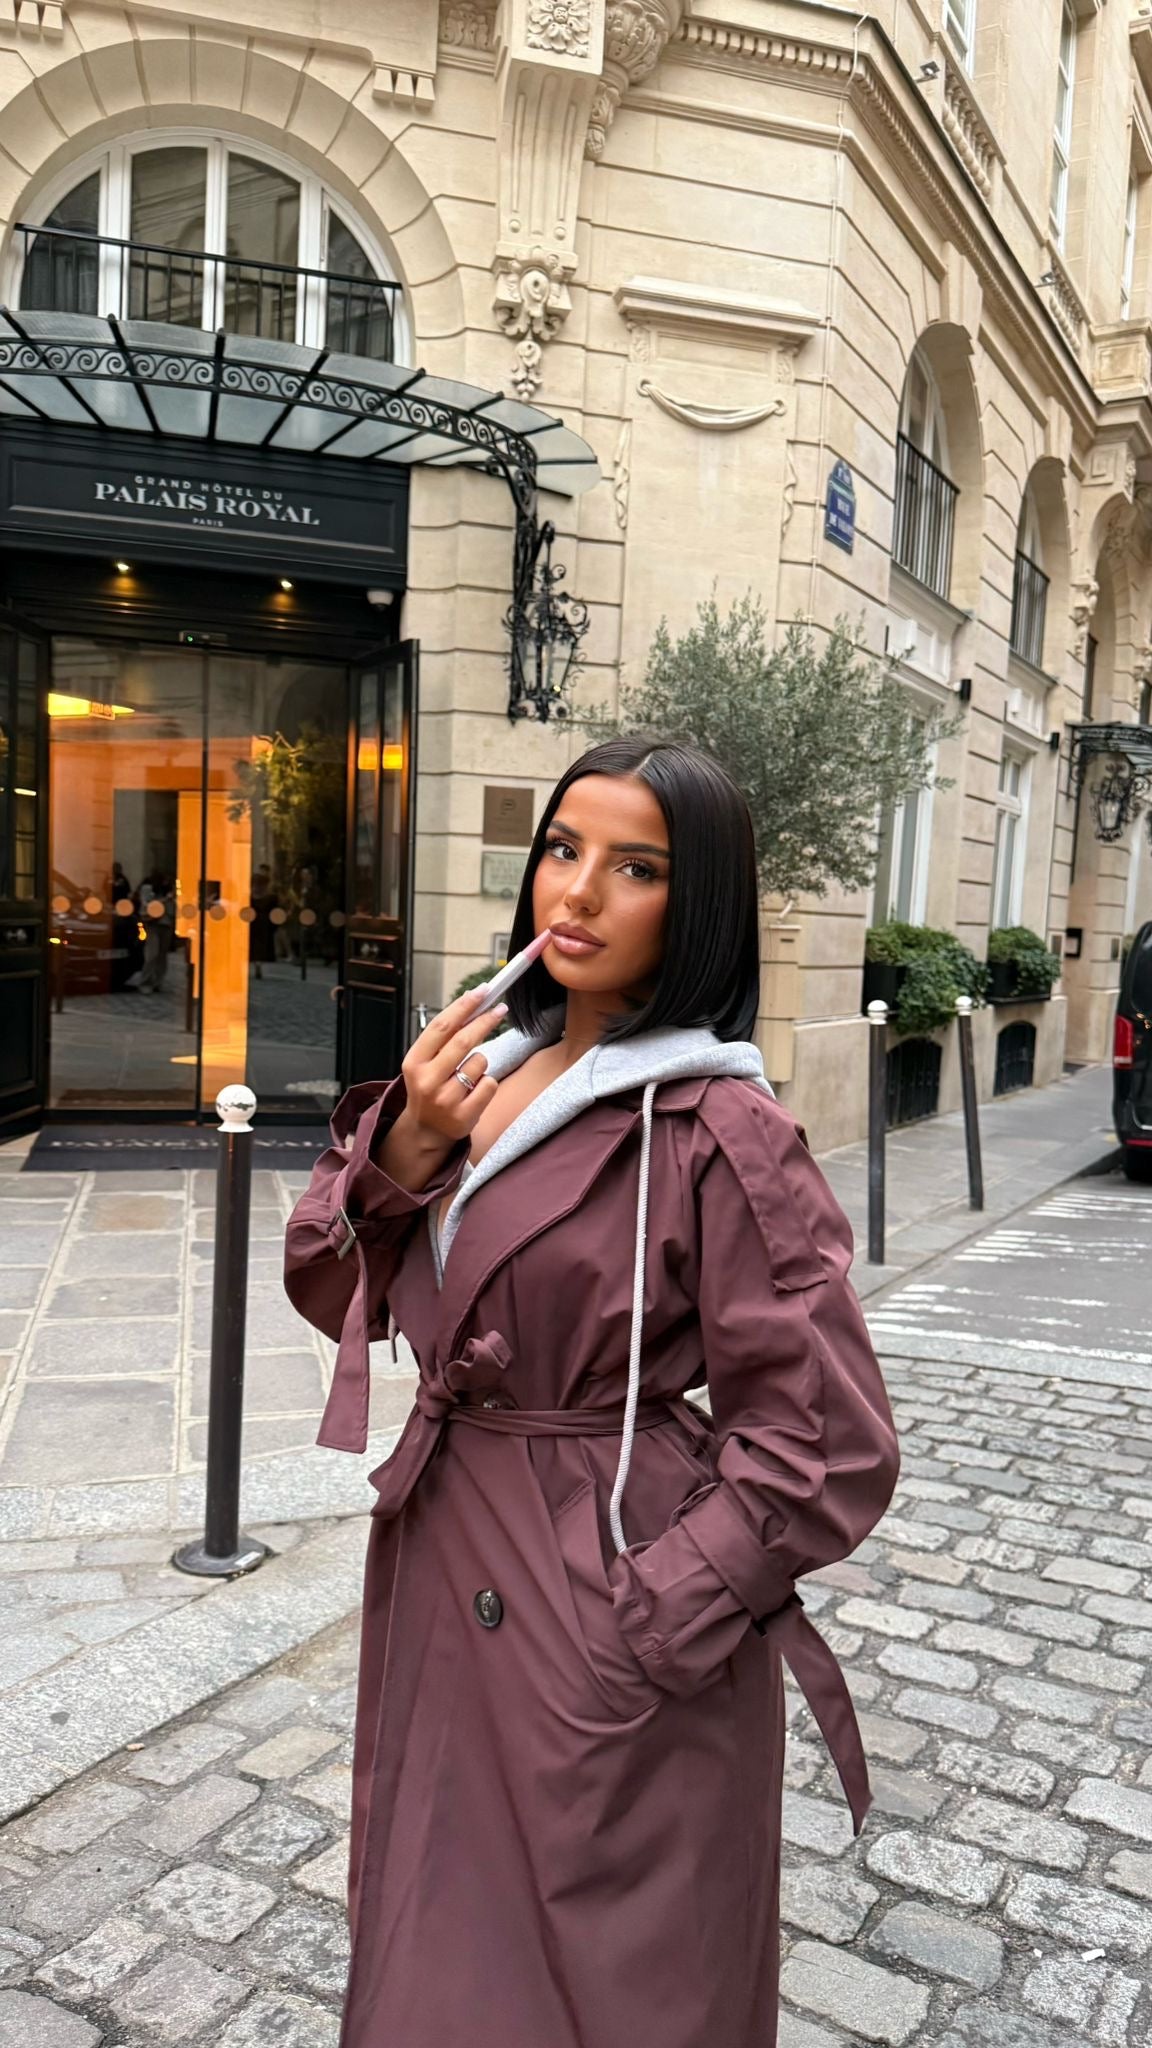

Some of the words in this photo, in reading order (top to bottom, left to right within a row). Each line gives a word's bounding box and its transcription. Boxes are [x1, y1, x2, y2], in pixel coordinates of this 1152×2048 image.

[134, 475, 192, 490] GRAND
[201, 483, 254, 498] HÔTEL
[262, 490, 283, 501] DU
[95, 482, 208, 512] PALAIS
[215, 496, 320, 526] ROYAL
[192, 517, 224, 528] PARIS
